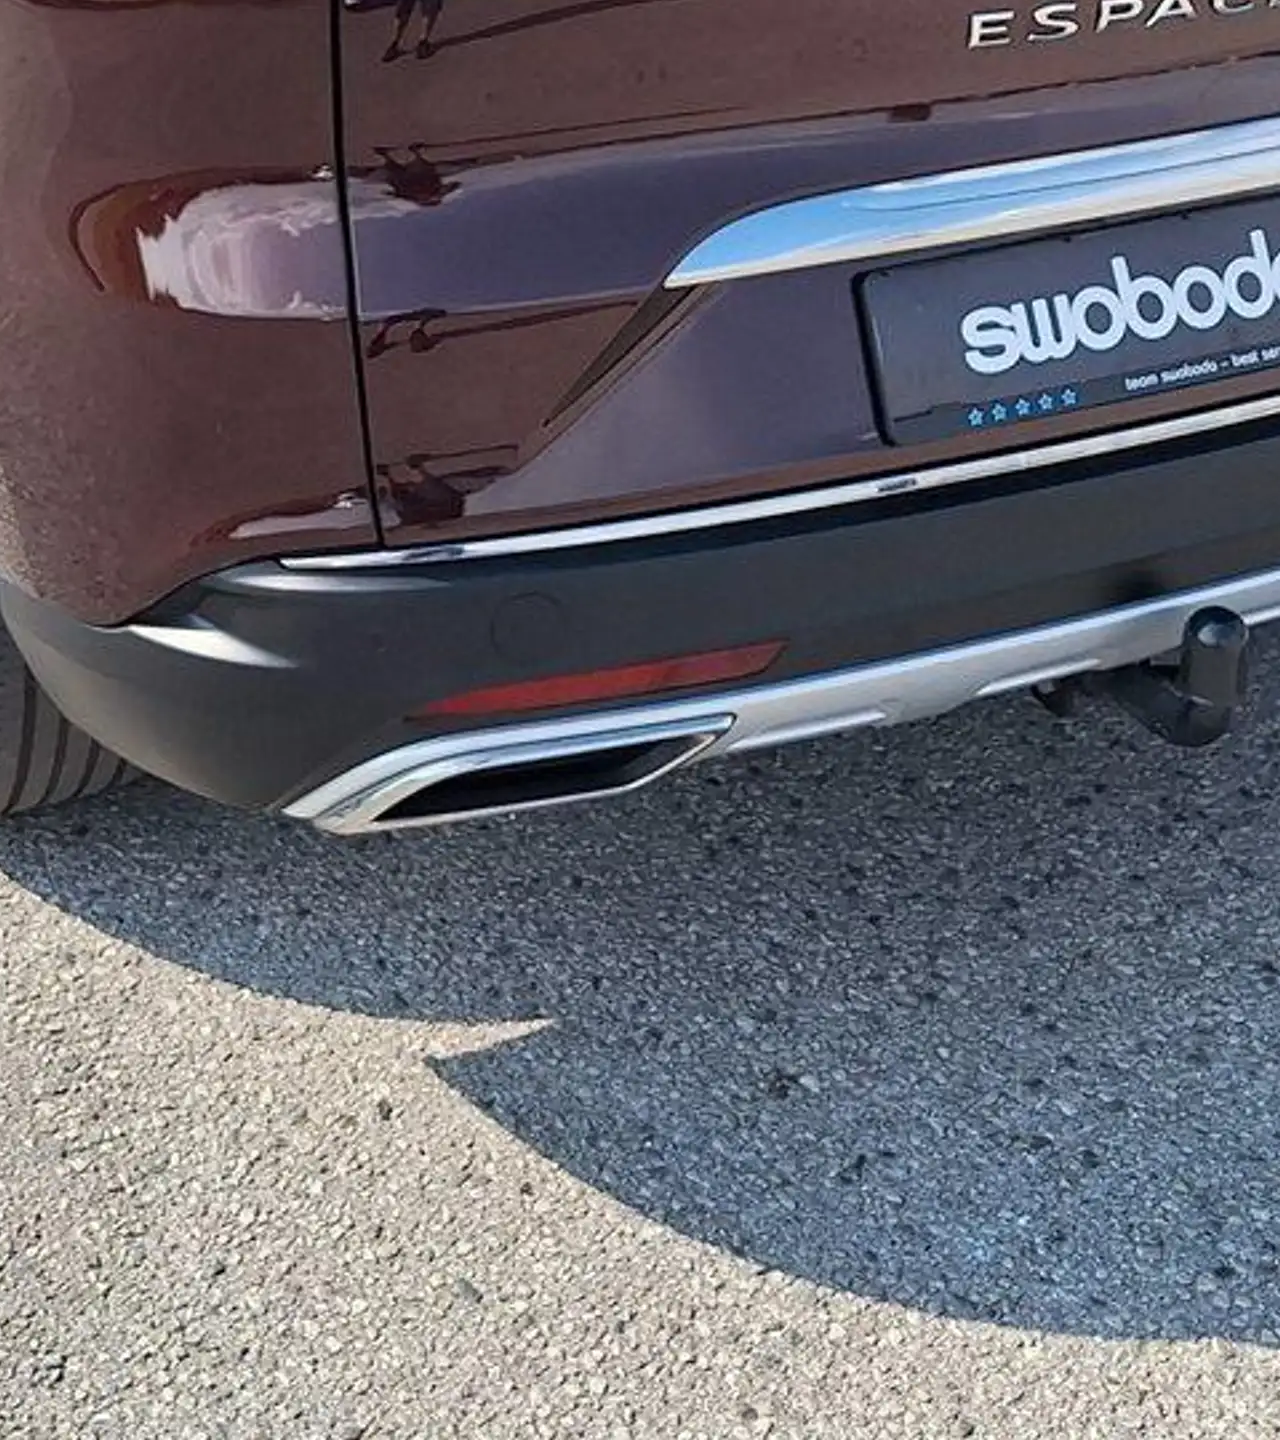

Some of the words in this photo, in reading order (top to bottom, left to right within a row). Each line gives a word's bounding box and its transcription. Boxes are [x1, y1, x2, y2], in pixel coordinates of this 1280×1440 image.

[1124, 372, 1159, 391] team
[1160, 359, 1219, 384] swoboda
[1229, 351, 1260, 368] best
